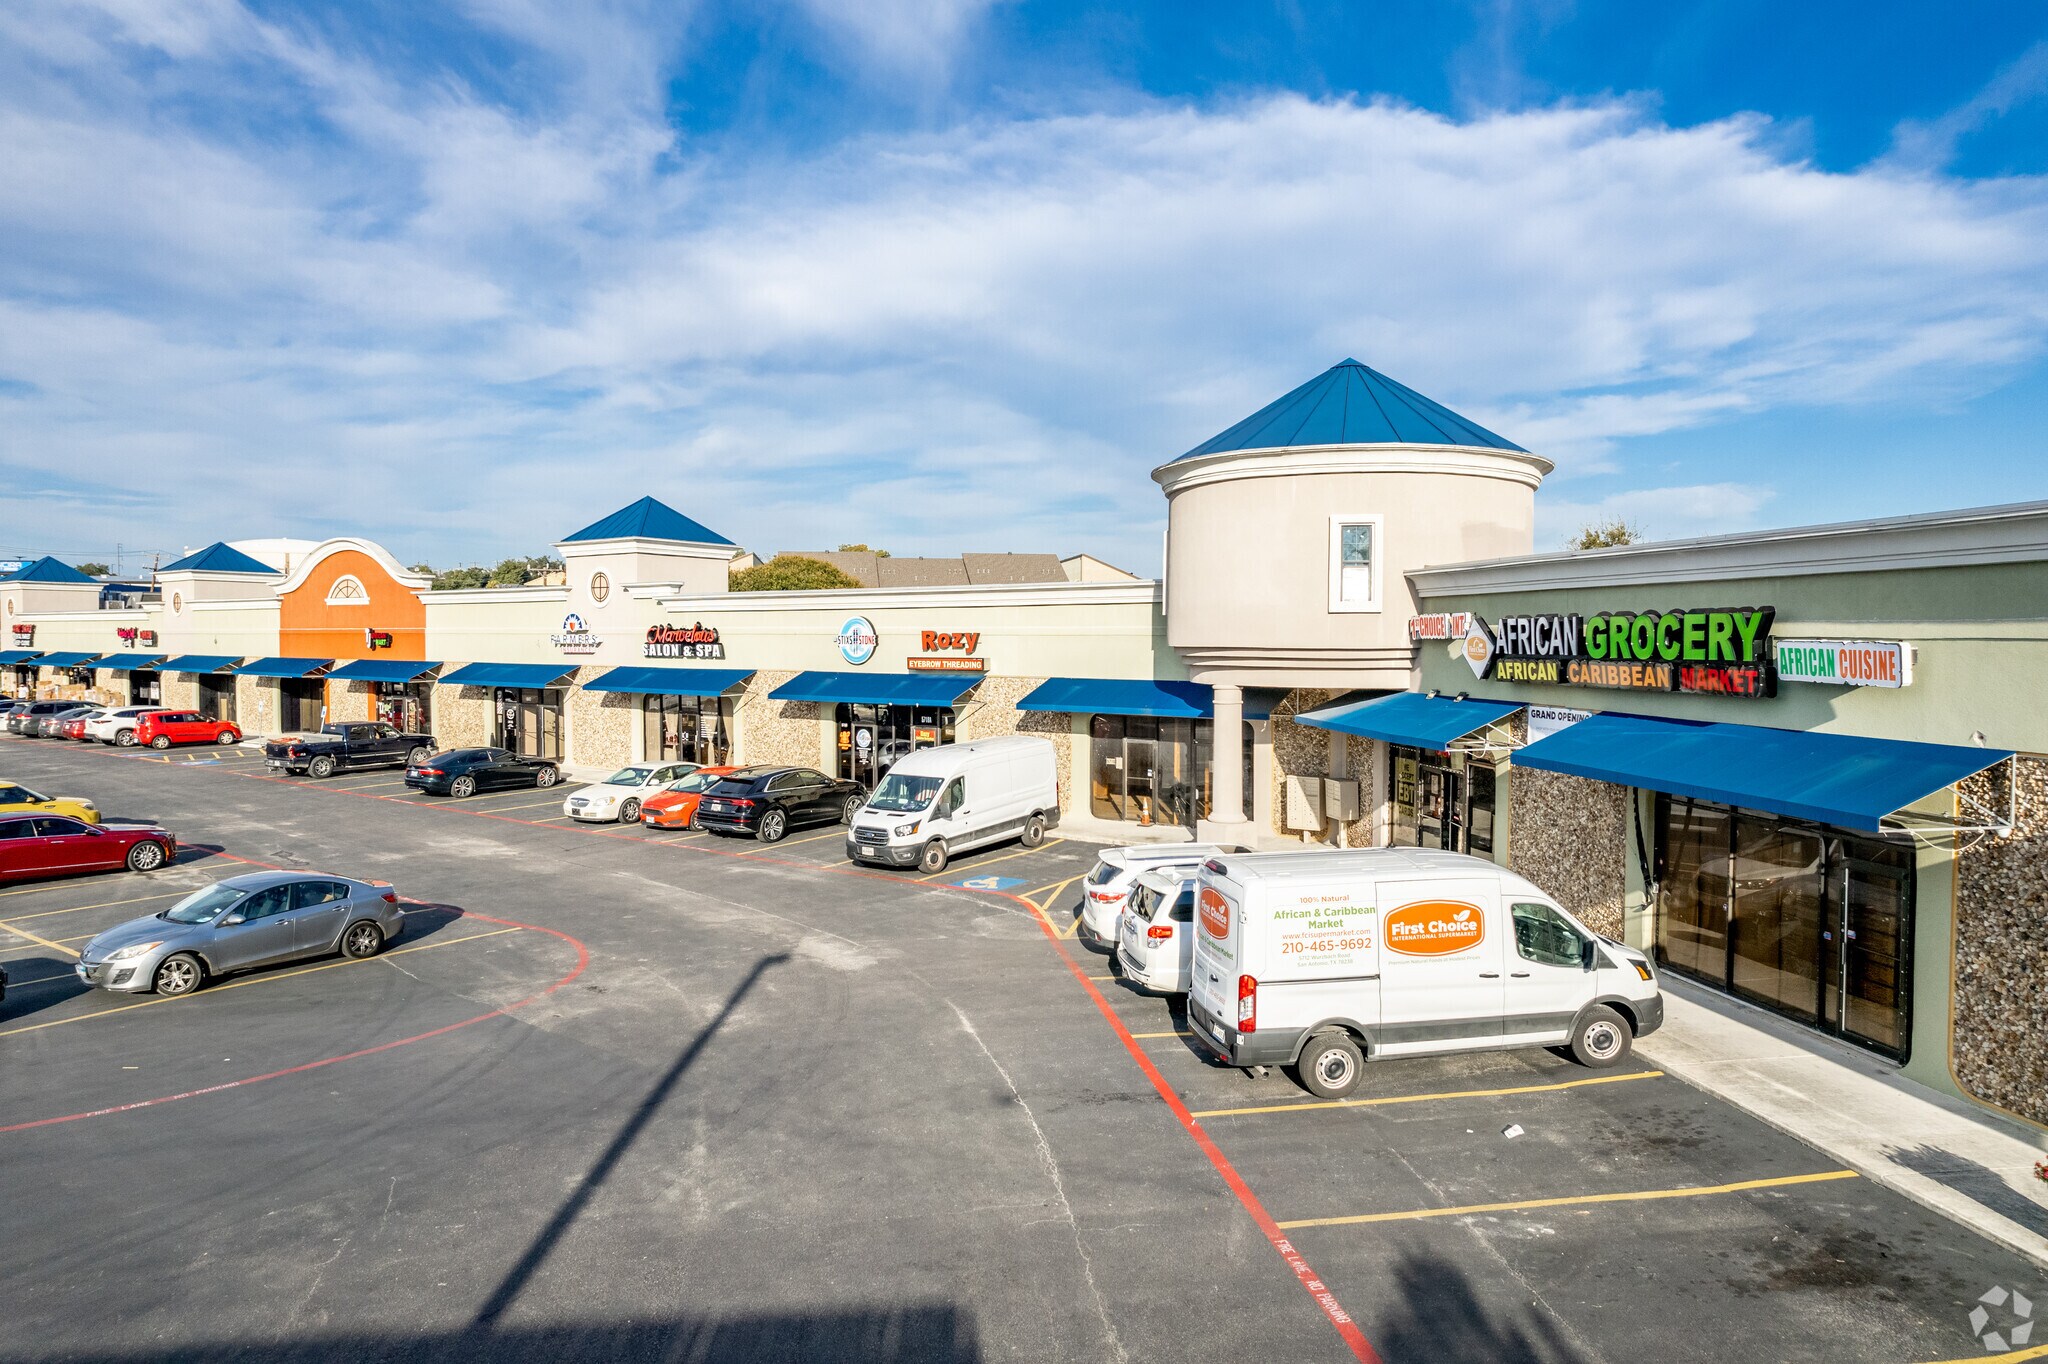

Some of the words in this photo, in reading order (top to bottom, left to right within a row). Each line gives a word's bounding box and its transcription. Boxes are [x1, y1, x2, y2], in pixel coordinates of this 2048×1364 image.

[646, 623, 715, 644] Marvelous
[1420, 616, 1445, 637] CHOICE
[550, 634, 598, 645] FARMERS
[858, 635, 875, 645] STONE
[921, 630, 979, 655] Rozy
[1495, 616, 1578, 656] AFRICAN
[1585, 612, 1763, 662] GROCERY
[643, 643, 679, 657] SALON
[683, 645, 694, 657] &
[695, 644, 721, 657] SPA
[909, 660, 942, 668] EYEBROW
[942, 660, 982, 669] THREADING
[1779, 647, 1836, 677] AFRICAN
[1838, 648, 1897, 681] CUISINE
[1497, 662, 1558, 681] AFRICAN
[1568, 663, 1670, 688] CARIBBEAN
[1681, 667, 1758, 693] MARKET
[1530, 709, 1556, 720] GRAND
[1398, 782, 1415, 804] EBT
[1299, 896, 1320, 904] 100%
[1321, 894, 1350, 903] Natural
[1273, 909, 1312, 920] African
[1313, 908, 1321, 917] &
[1323, 905, 1376, 917] Caribbean
[1308, 919, 1344, 929] Market
[1391, 921, 1425, 936] First
[1428, 919, 1478, 933] Choice
[1282, 928, 1371, 940] www.fcisupermarket.com
[1391, 934, 1437, 942] INTERNATIONAL
[1438, 930, 1478, 938] SUPERMARKET
[1282, 937, 1372, 954] 210-465-9692
[86, 1107, 113, 1117] FIRE
[121, 1100, 153, 1110] LANE
[173, 1092, 189, 1100] NO
[195, 1081, 240, 1095] PARKING
[1274, 1239, 1296, 1255] FIRE
[1287, 1256, 1311, 1275] LANE
[1307, 1280, 1325, 1291] NO
[1316, 1292, 1352, 1324] PARKING
